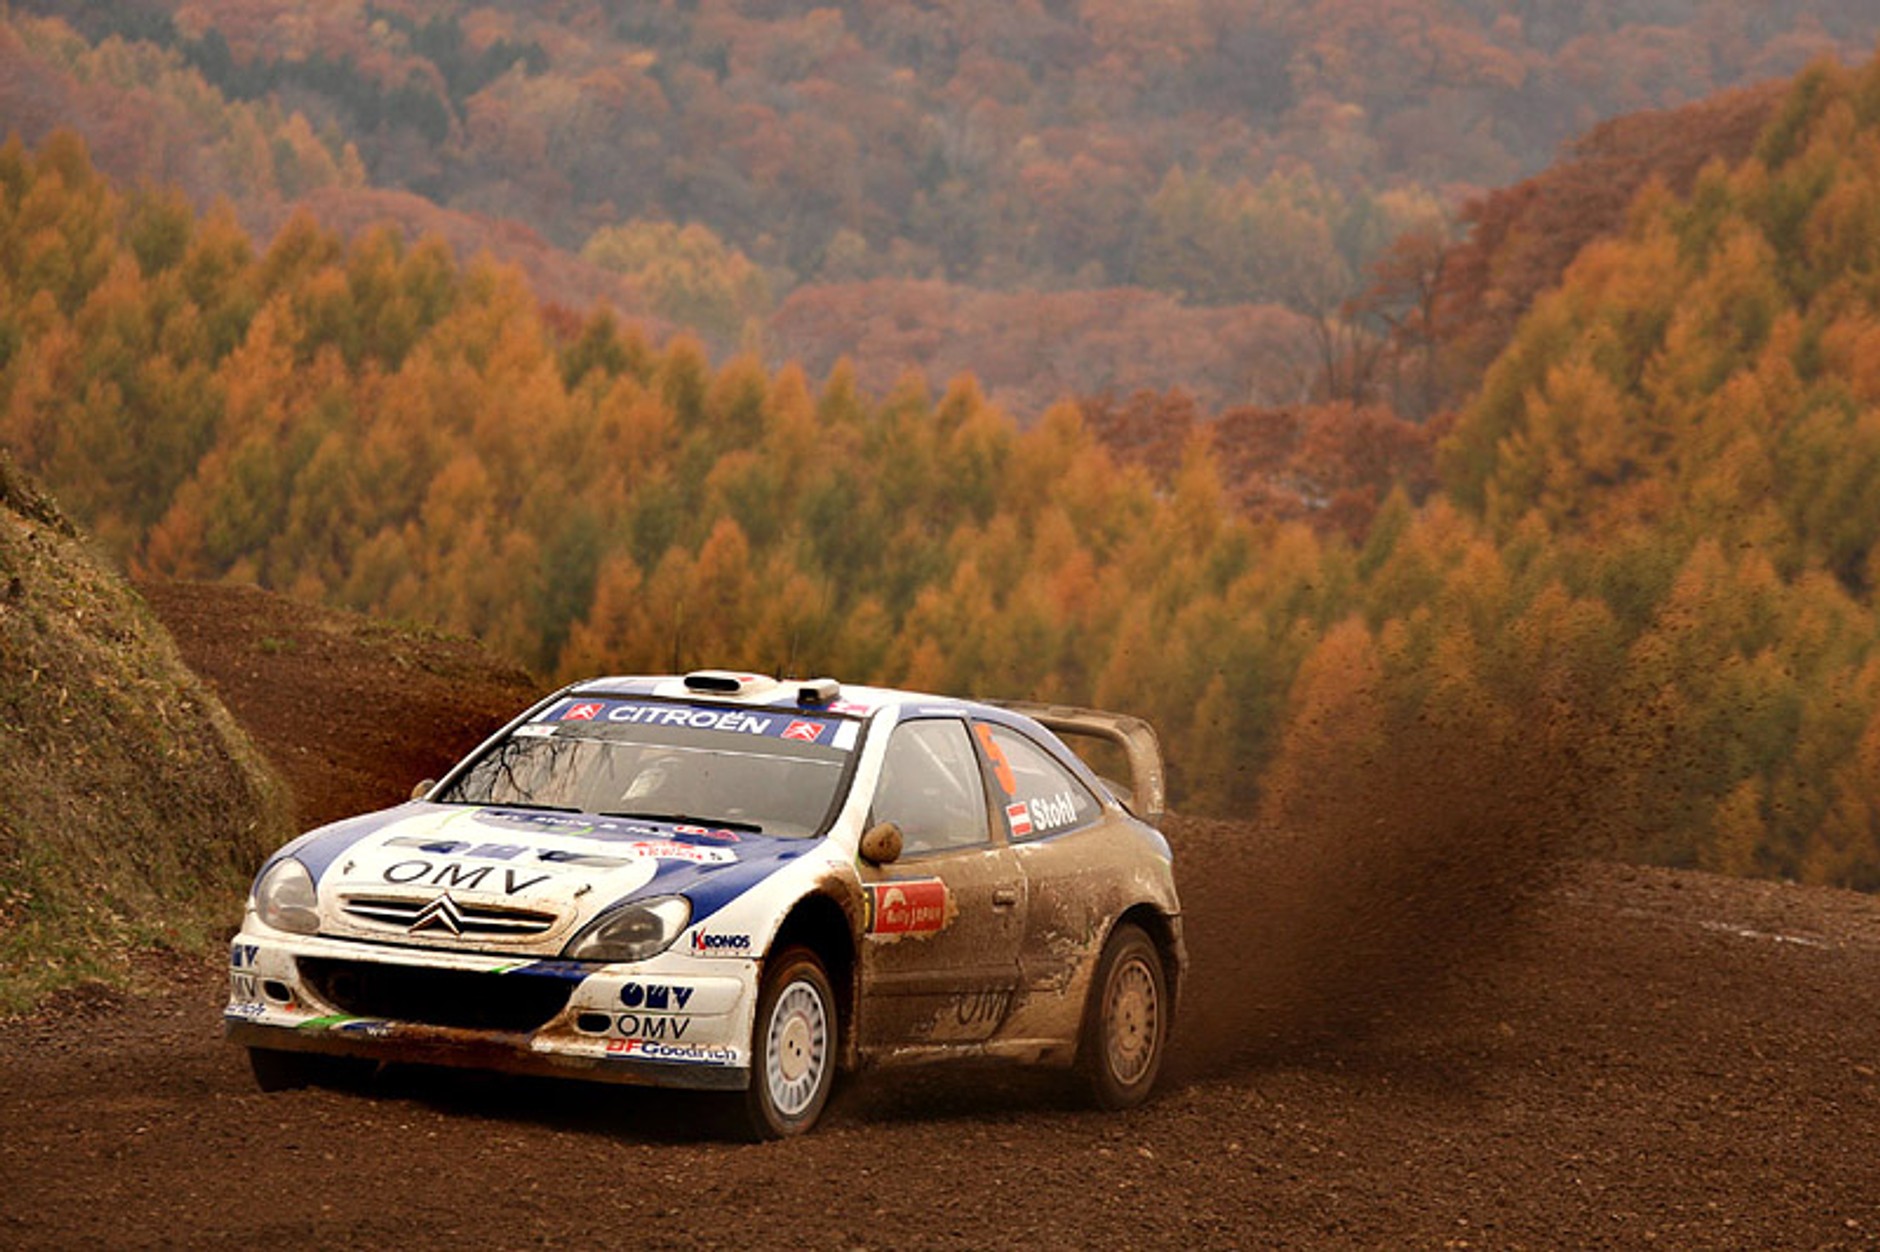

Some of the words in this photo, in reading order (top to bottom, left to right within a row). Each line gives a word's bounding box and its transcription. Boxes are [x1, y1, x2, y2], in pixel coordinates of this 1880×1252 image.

[608, 705, 771, 735] CITROËN
[1030, 792, 1078, 831] Stohl
[383, 859, 552, 895] OMV
[691, 928, 750, 950] KRONOS
[617, 1014, 690, 1039] OMV
